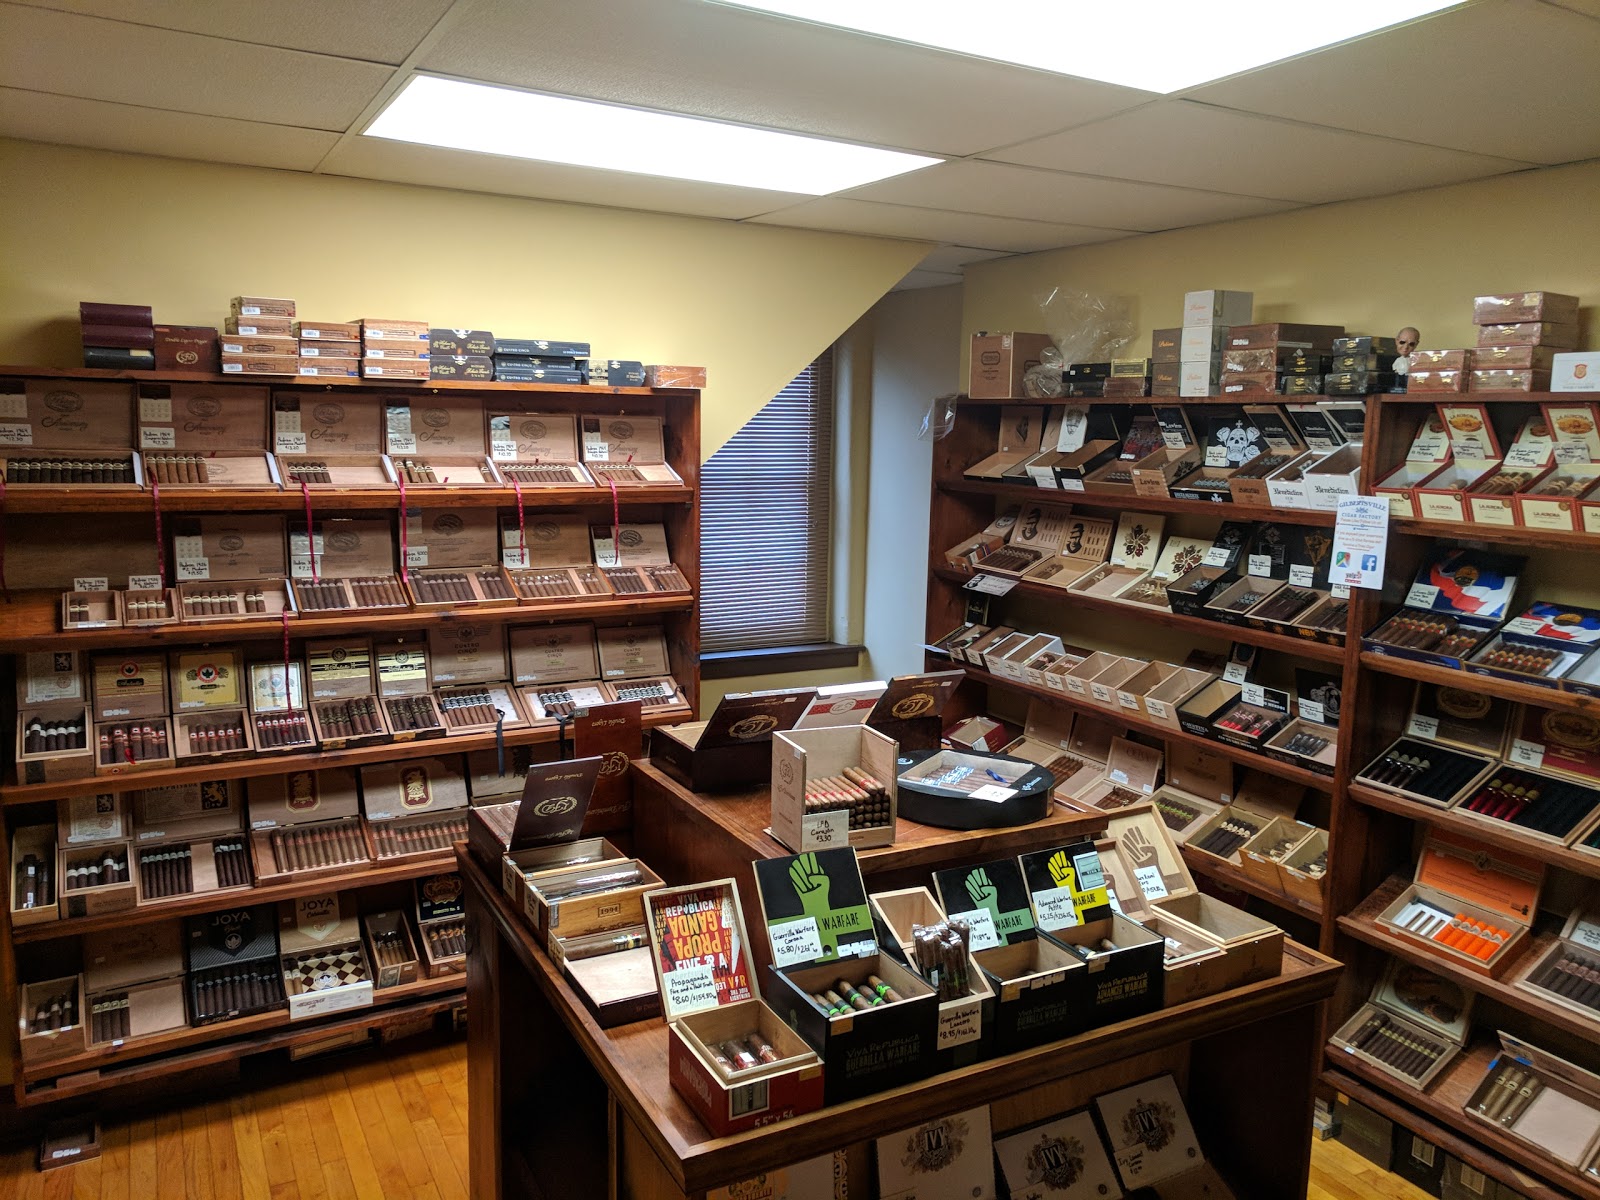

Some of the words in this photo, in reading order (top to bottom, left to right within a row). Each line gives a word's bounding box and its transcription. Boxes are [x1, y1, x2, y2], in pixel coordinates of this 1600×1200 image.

[1273, 487, 1303, 497] Benediction
[1314, 485, 1349, 495] Benediction
[1339, 500, 1386, 512] GILBERTSVILLE
[1298, 627, 1317, 637] NBK
[454, 642, 480, 650] CUATRO
[299, 897, 335, 912] JOYA
[1073, 893, 1097, 908] WARFARE
[600, 906, 619, 915] 1994
[211, 911, 251, 926] JOYA
[668, 910, 719, 938] GANDA
[821, 912, 860, 931] WARFARE
[994, 914, 1024, 931] WARFARE
[672, 931, 723, 961] PROPA
[784, 936, 804, 945] Corona
[671, 973, 709, 987] Propaganda
[949, 1018, 971, 1029] Lancero
[846, 1052, 885, 1073] GUERRILLA
[886, 1041, 921, 1061] WARFARE
[1136, 1109, 1158, 1133] IVY
[925, 1125, 947, 1150] IVY
[1041, 1144, 1066, 1171] IVY
